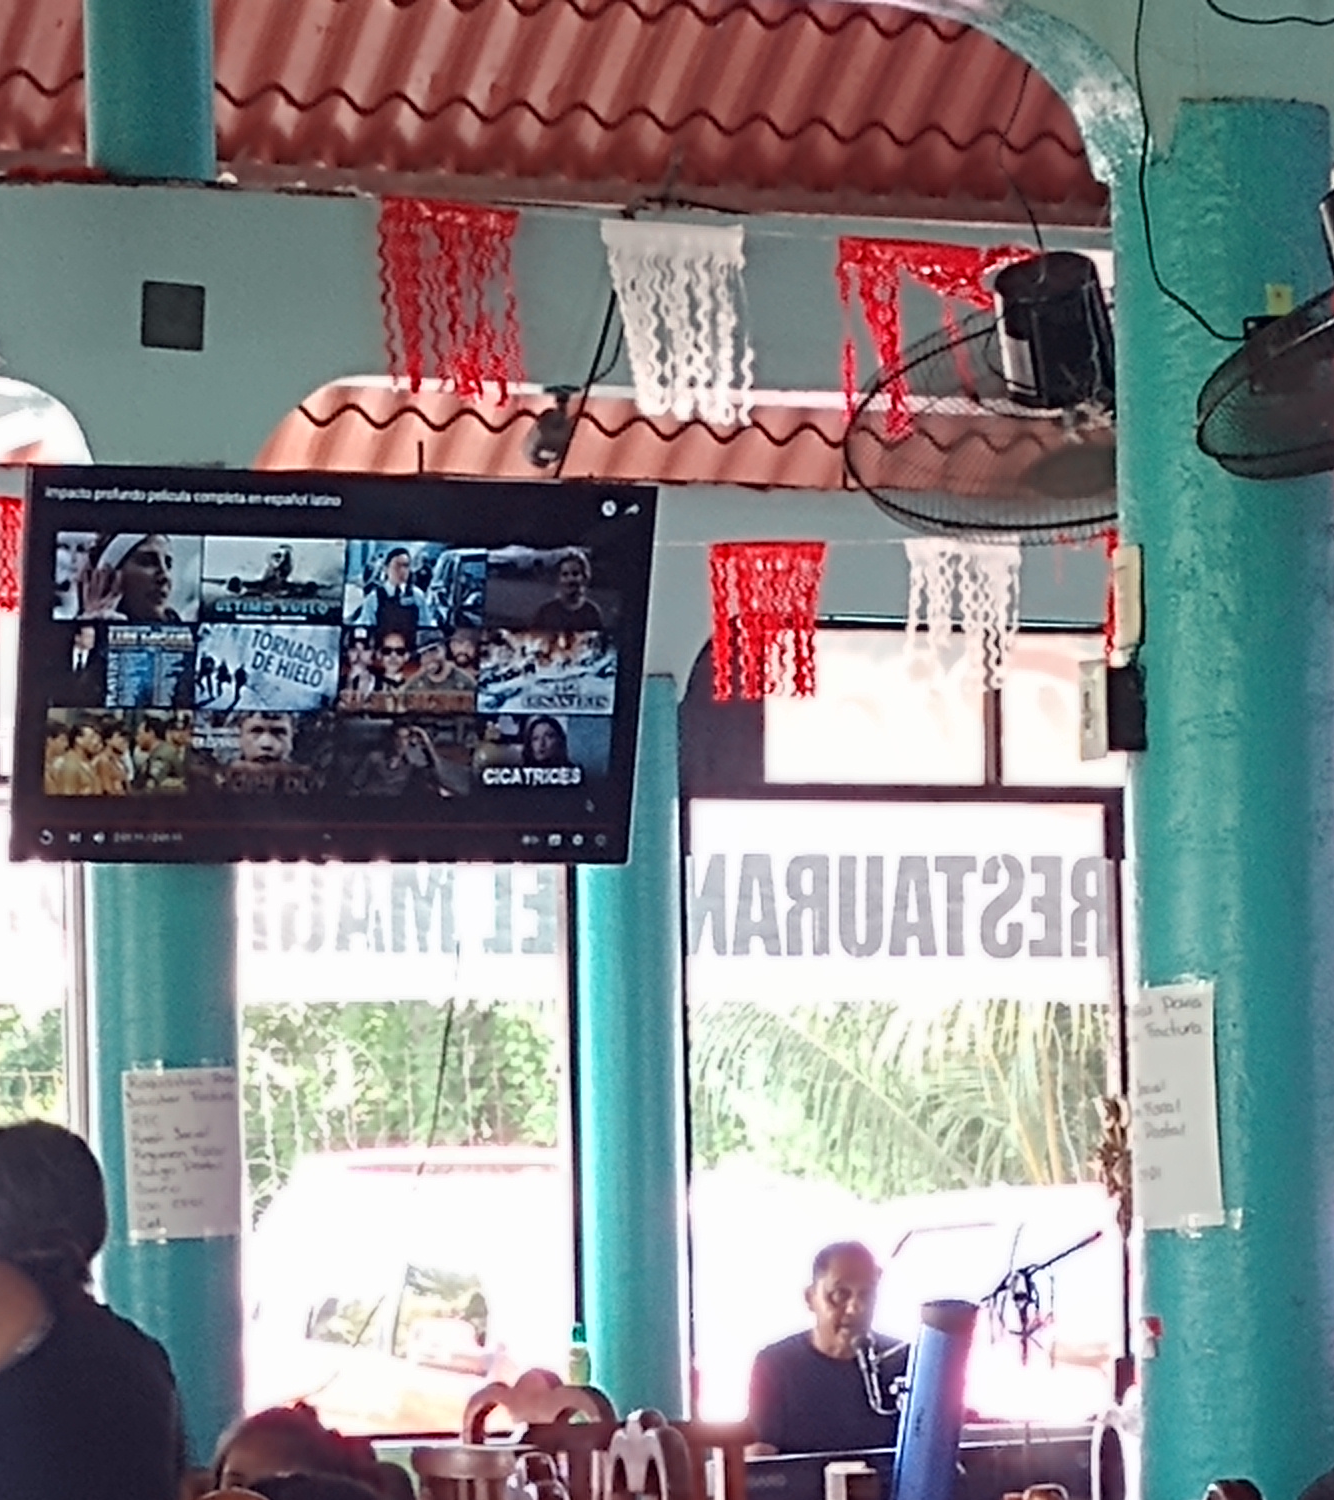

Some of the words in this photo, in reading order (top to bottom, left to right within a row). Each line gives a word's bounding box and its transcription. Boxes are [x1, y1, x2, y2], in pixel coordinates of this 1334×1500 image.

[193, 491, 245, 505] completa
[248, 494, 262, 505] en
[251, 651, 274, 673] DE
[275, 658, 324, 688] HIELO
[482, 767, 582, 786] CICATRICES
